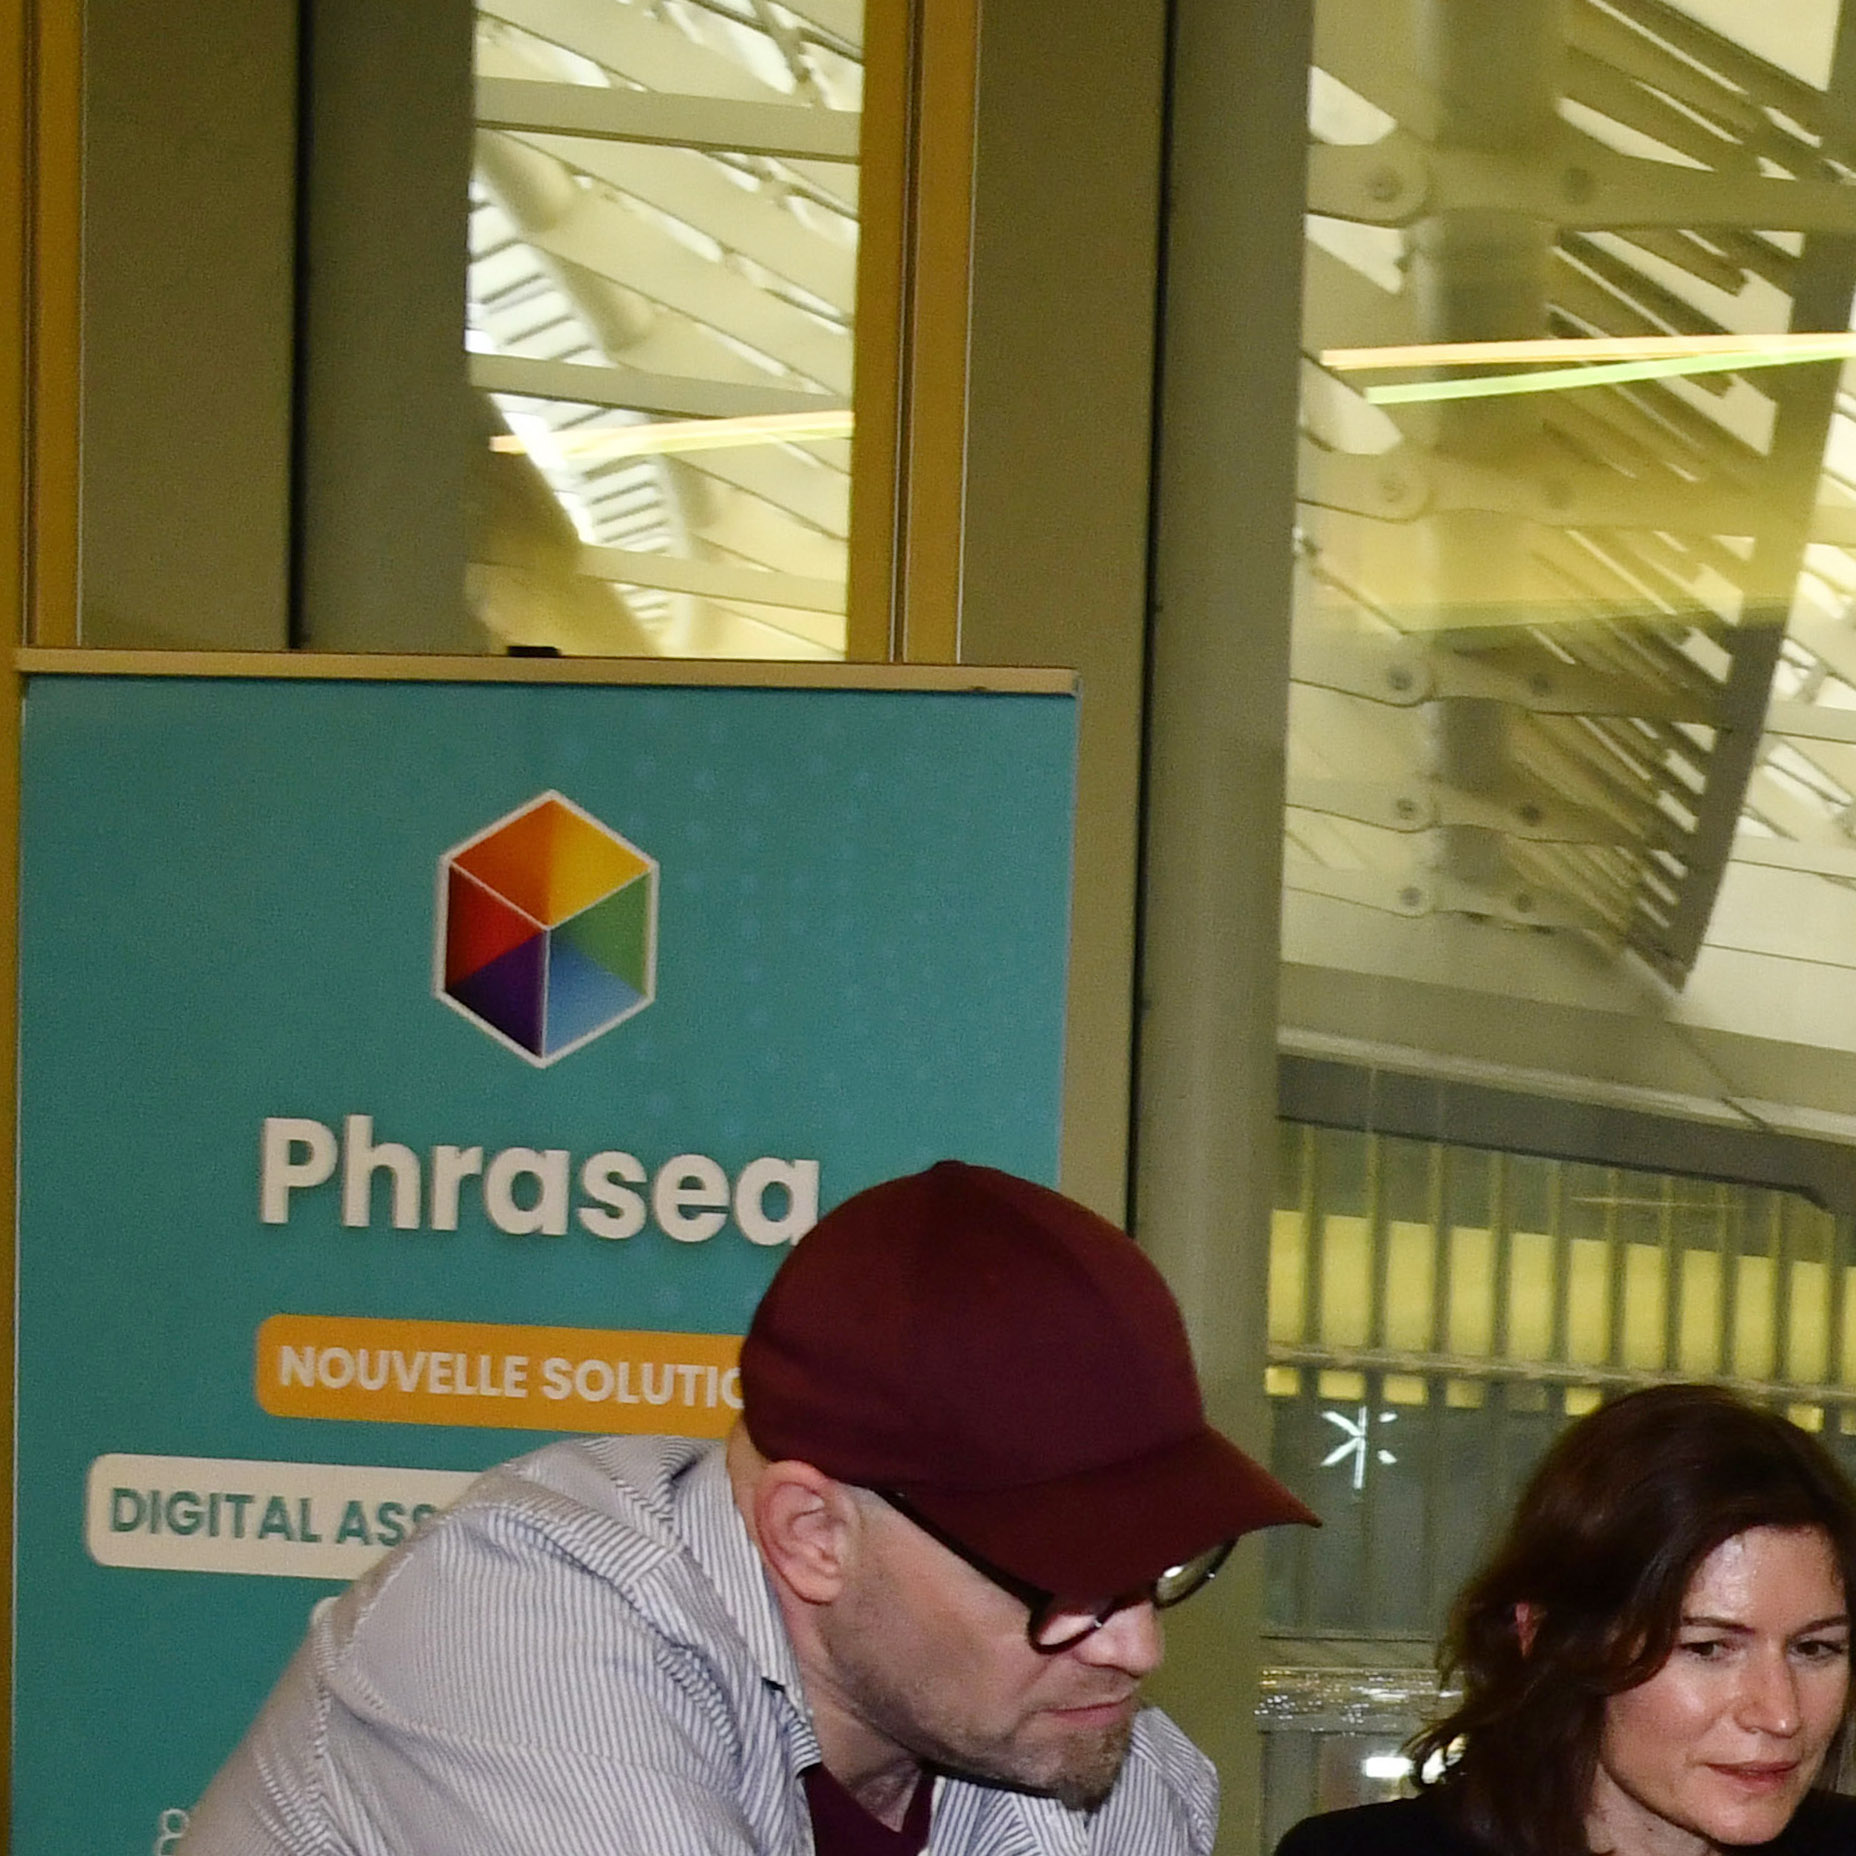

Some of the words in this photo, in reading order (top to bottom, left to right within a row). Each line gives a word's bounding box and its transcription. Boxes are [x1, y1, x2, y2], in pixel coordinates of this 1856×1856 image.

[261, 1114, 820, 1246] Phrasea
[278, 1345, 529, 1399] NOUVELLE
[110, 1487, 322, 1543] DIGITAL
